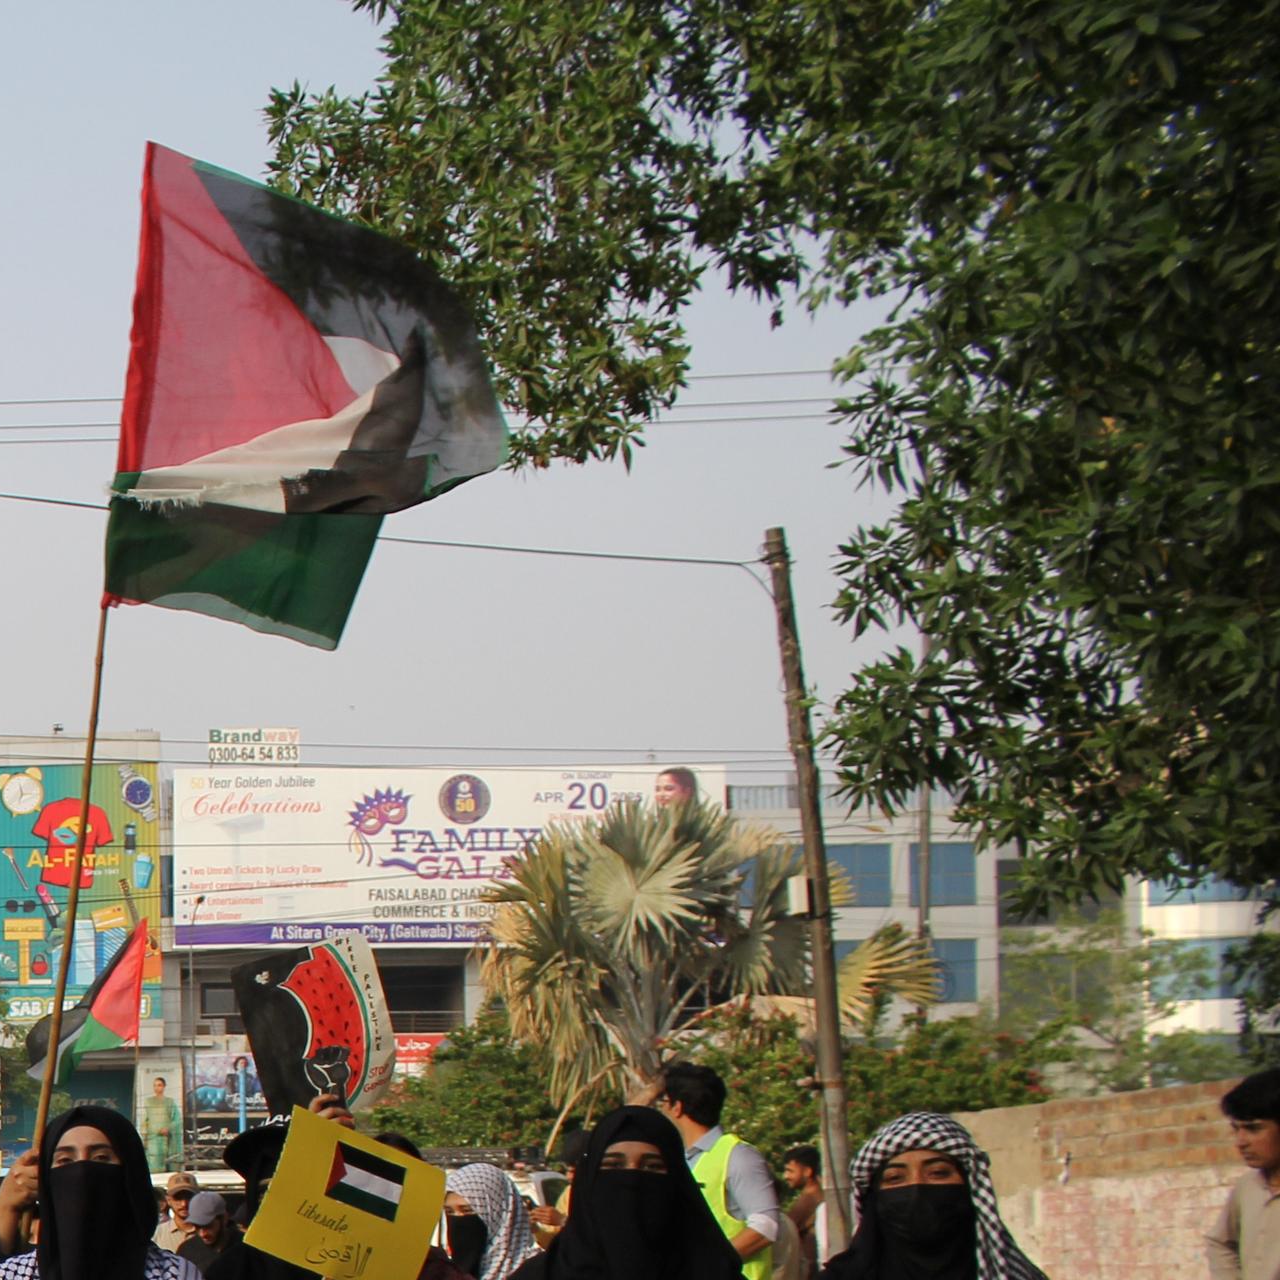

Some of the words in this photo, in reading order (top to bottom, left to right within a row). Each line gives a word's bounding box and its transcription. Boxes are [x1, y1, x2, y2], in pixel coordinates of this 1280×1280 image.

[208, 729, 299, 745] Brandway
[258, 746, 273, 761] 54
[276, 746, 299, 761] 833
[208, 777, 232, 789] Year
[235, 776, 273, 788] Golden
[275, 775, 316, 788] Jubilee
[533, 792, 563, 803] APR
[567, 782, 608, 810] 20
[192, 792, 322, 817] Celebrations
[391, 828, 542, 853] FAMILY
[369, 888, 447, 901] FAISALABAD
[373, 905, 448, 918] COMMERCE
[271, 927, 283, 939] At
[287, 926, 322, 939] Sitara
